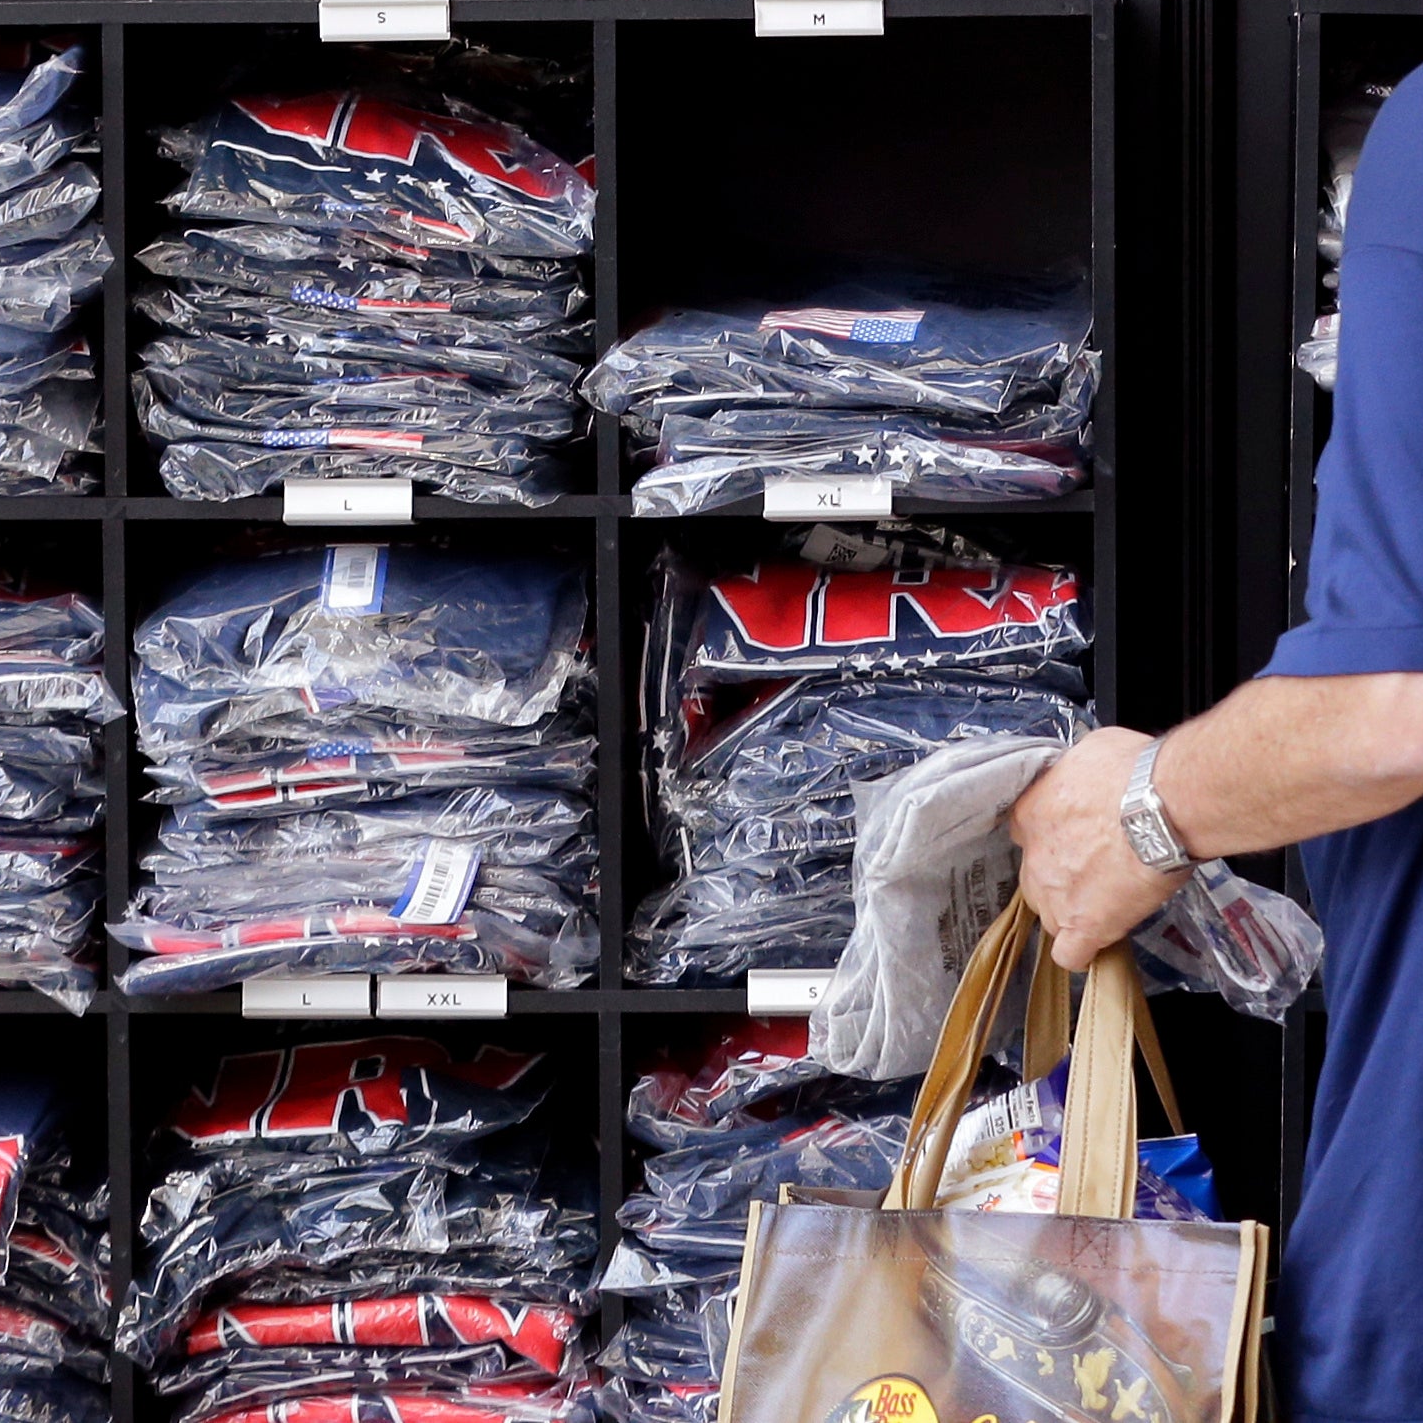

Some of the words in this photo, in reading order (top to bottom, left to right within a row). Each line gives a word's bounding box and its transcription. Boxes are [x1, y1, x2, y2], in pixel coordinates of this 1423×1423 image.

[376, 11, 387, 24] S
[813, 13, 825, 25] M
[344, 499, 353, 511] L
[302, 993, 311, 1005] L
[808, 987, 818, 999] S
[426, 993, 462, 1006] XXL
[874, 1384, 917, 1416] Bass
